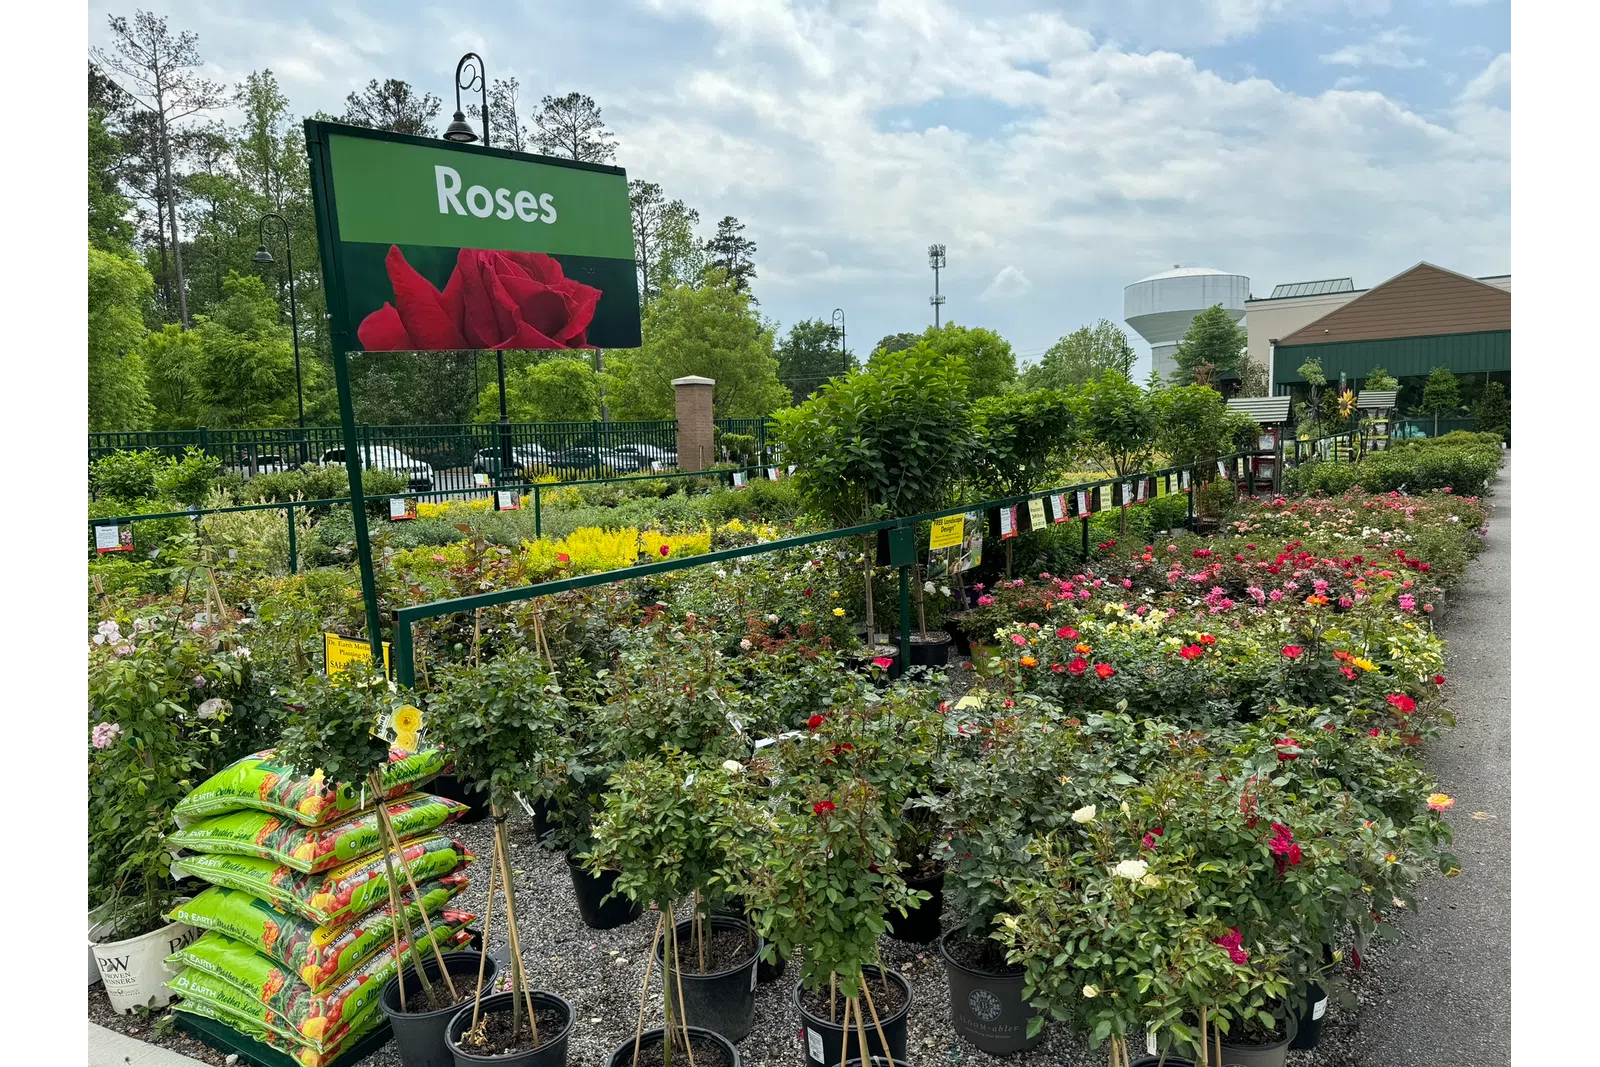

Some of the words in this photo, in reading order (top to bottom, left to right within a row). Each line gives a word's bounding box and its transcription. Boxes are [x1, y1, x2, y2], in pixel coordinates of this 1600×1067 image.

[434, 164, 558, 225] Roses
[340, 649, 361, 659] Planting
[354, 643, 371, 651] Mothe
[396, 763, 421, 780] Land
[397, 815, 425, 834] Land
[245, 866, 268, 880] Land
[178, 910, 189, 921] DR
[191, 912, 216, 925] EARTH
[215, 918, 241, 935] Mother
[241, 929, 260, 945] Land
[335, 928, 353, 942] CUBIC
[371, 924, 384, 936] DR
[97, 955, 130, 973] PW
[104, 971, 131, 980] PROVEN
[190, 953, 216, 970] EARTH
[216, 964, 240, 983] Mother
[240, 976, 260, 994] Land
[338, 975, 357, 990] CUBIC
[356, 963, 370, 976] FEET
[375, 968, 389, 981] DR
[176, 976, 190, 988] DR
[190, 982, 217, 998] EARTH
[216, 991, 241, 1009] Mother
[240, 1003, 264, 1017] Land
[183, 999, 193, 1009] DR
